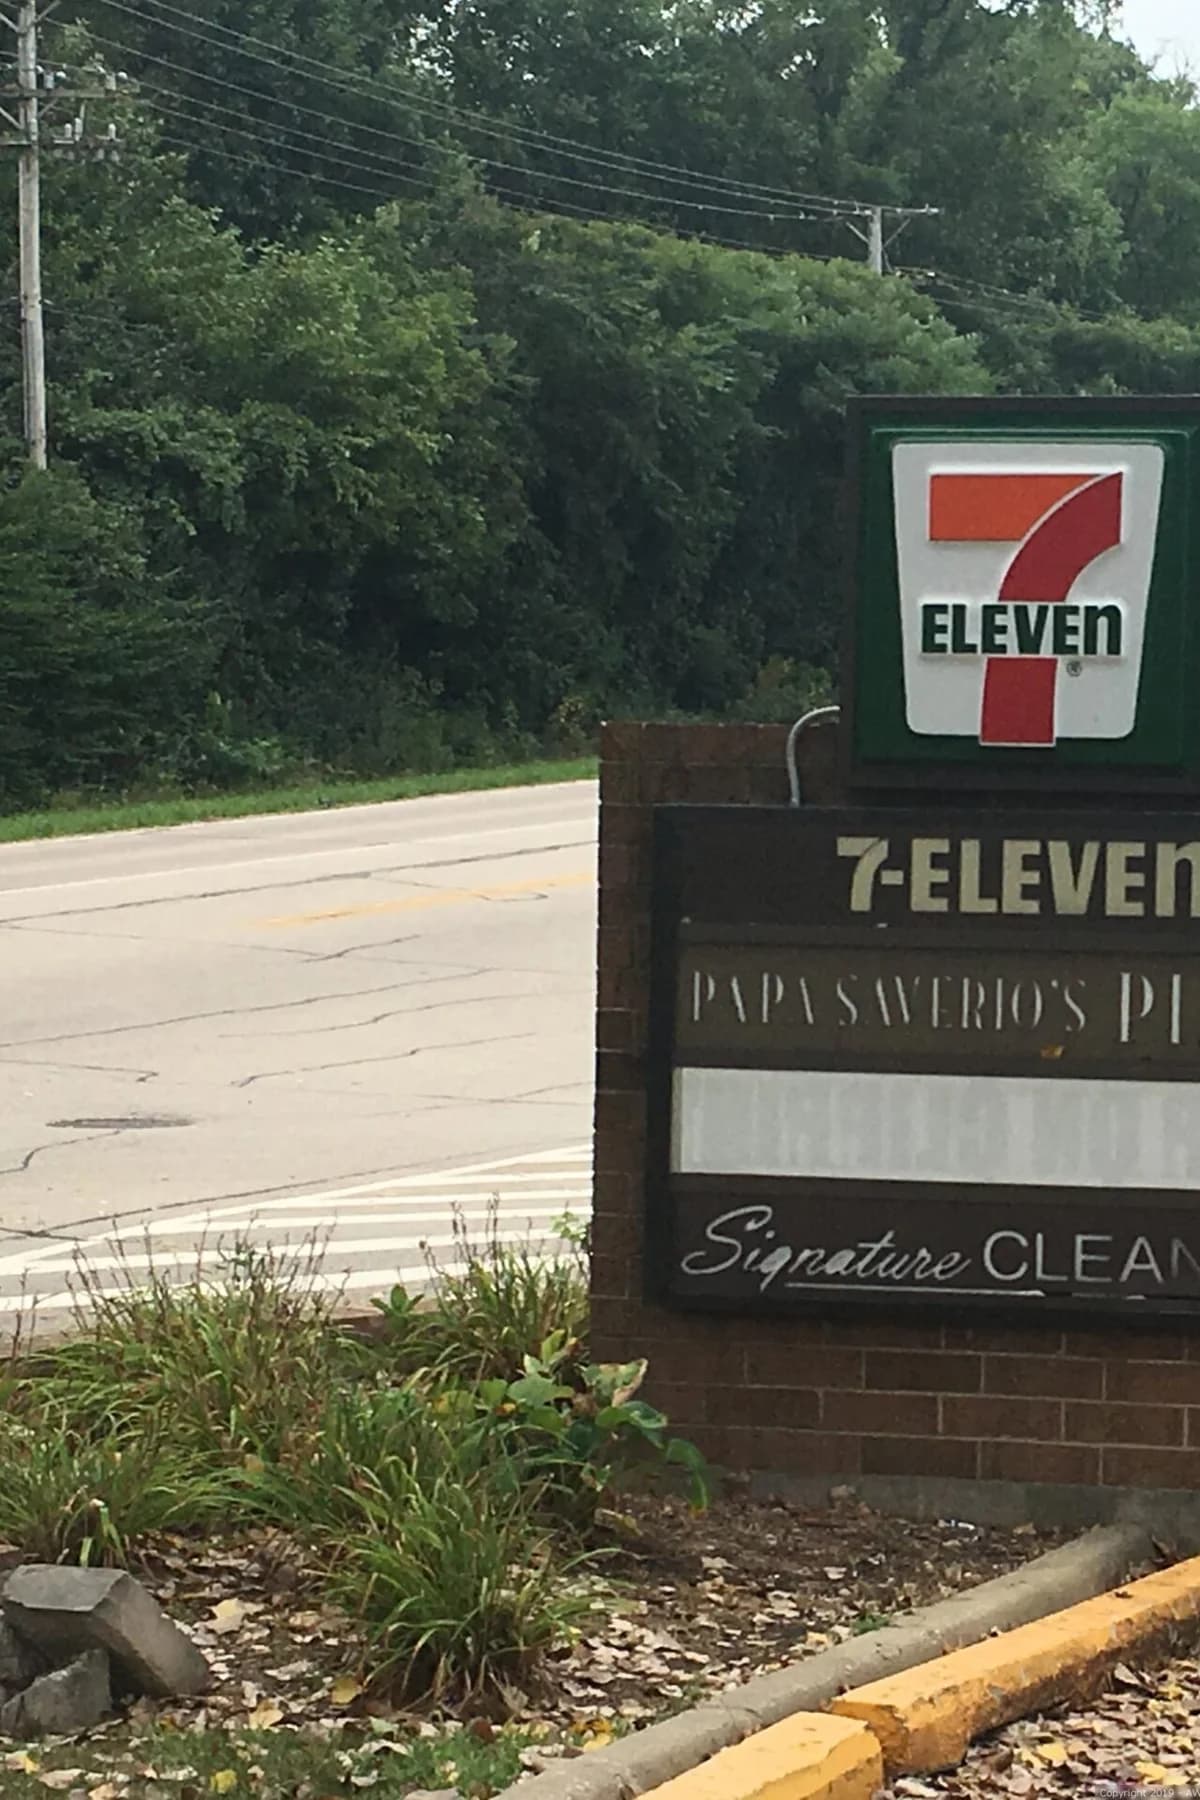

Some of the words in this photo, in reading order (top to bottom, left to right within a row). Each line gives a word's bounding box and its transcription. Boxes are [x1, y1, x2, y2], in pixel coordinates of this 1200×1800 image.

[929, 471, 1123, 744] 7
[693, 971, 814, 1024] PAPA
[836, 974, 1086, 1032] SAVERIO'S
[681, 1205, 971, 1293] Signature
